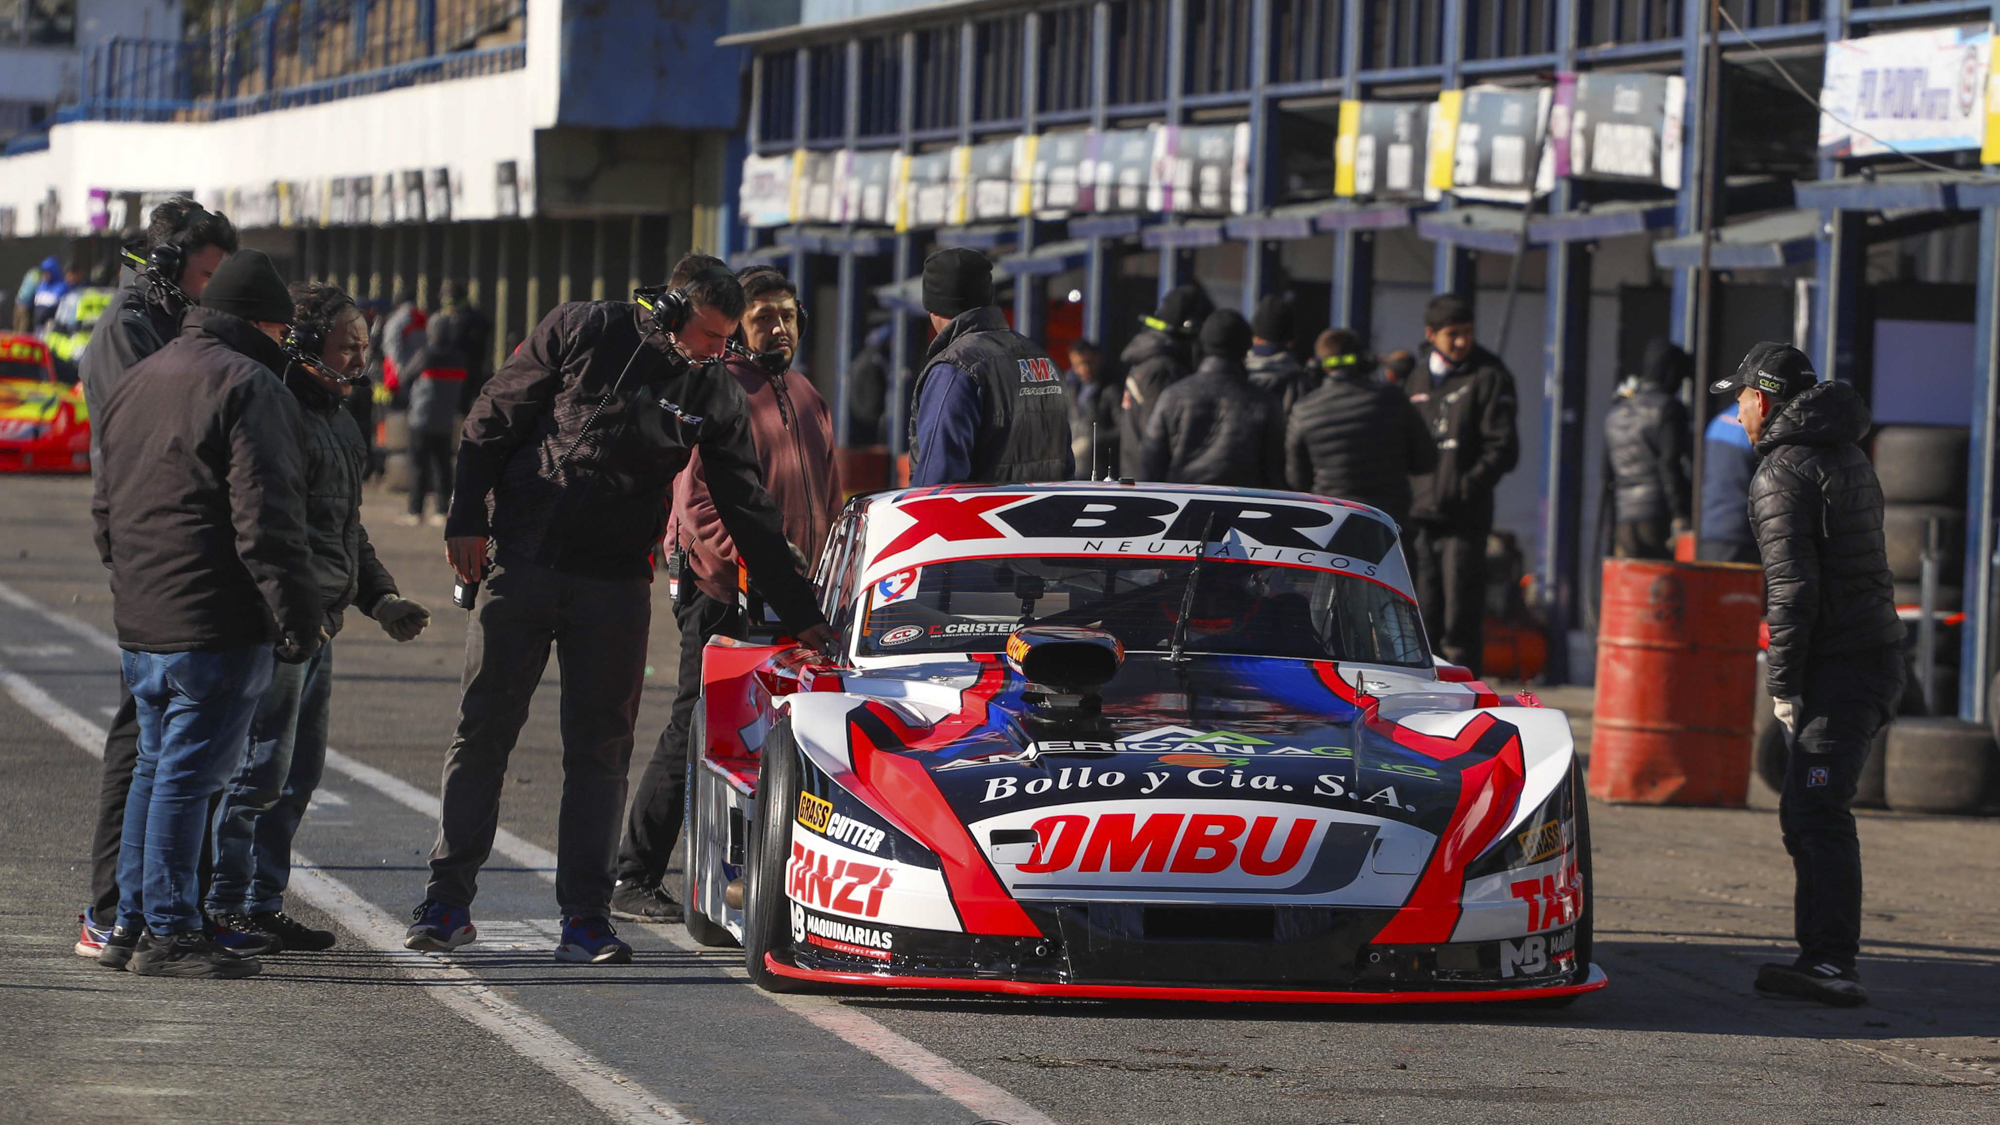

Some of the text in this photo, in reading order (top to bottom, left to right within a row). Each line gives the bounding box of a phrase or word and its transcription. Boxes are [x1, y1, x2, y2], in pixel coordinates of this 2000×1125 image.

[1017, 358, 1059, 382] AMA
[932, 741, 1256, 770] AMERICAN
[980, 767, 1126, 803] Bollo
[1140, 771, 1170, 794] y
[1187, 769, 1294, 792] Cia.
[800, 795, 885, 853] GRASS CUTTER
[1014, 813, 1318, 876] OMBU
[789, 840, 895, 918] TANZI
[790, 900, 893, 949] MB MAQUINARIAS
[1500, 936, 1547, 978] MB
